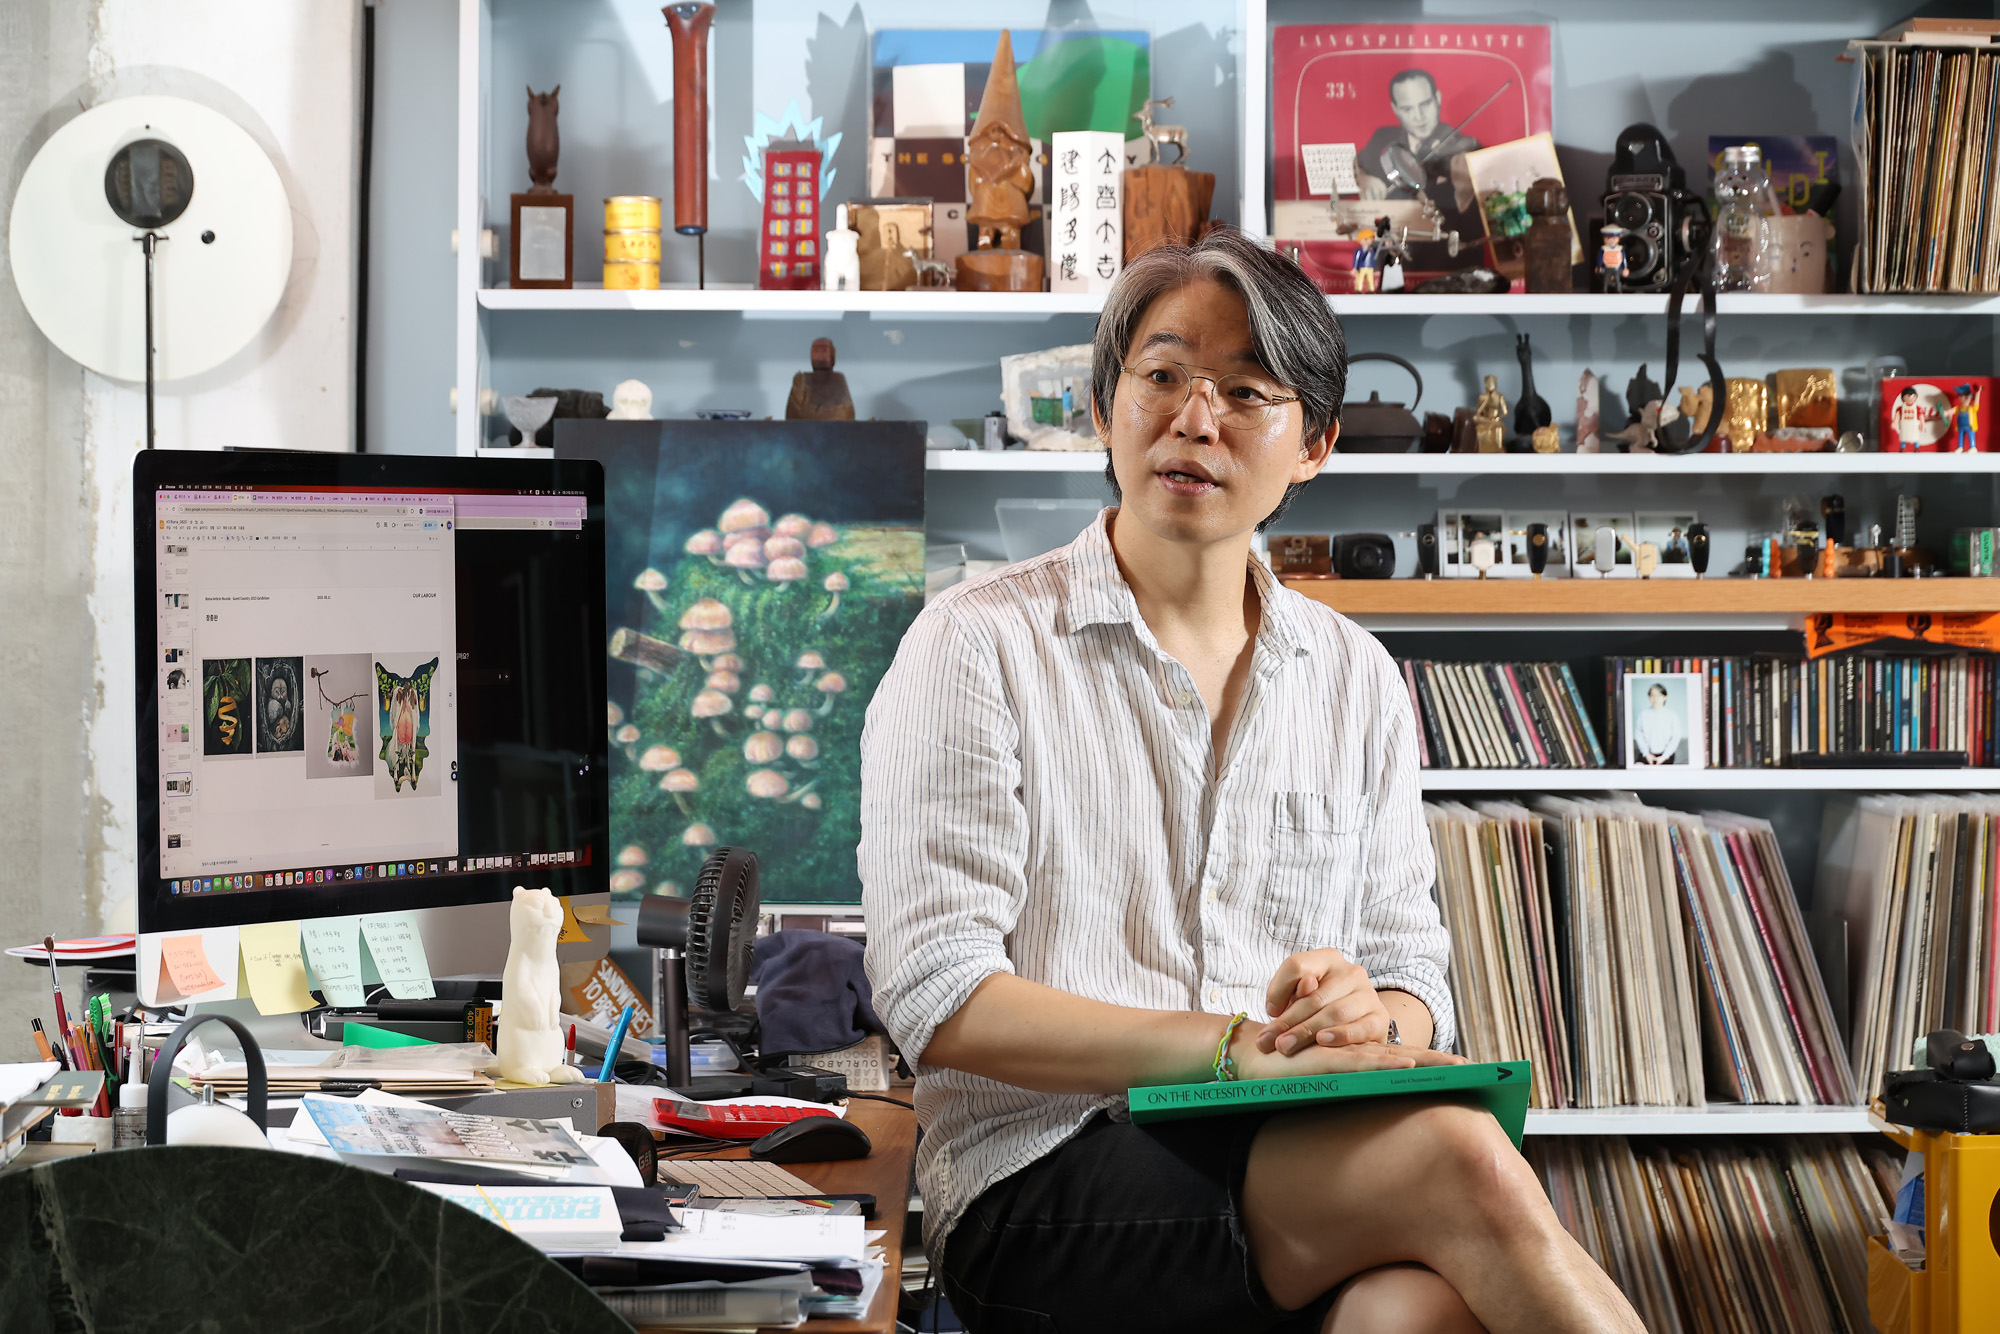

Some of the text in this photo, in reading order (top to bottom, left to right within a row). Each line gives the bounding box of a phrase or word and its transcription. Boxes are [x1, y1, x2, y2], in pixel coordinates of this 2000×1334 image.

[1300, 34, 1524, 48] LANGSPIELPLATTE
[582, 977, 620, 1022] TO BRE
[597, 959, 653, 1034] SANDWICHES
[1148, 1093, 1168, 1104] ON
[1170, 1090, 1190, 1102] THE
[1194, 1086, 1249, 1101] NECESSITY
[1251, 1085, 1267, 1096] OF
[1270, 1079, 1339, 1095] GARDENING
[480, 1204, 601, 1220] PROTO
